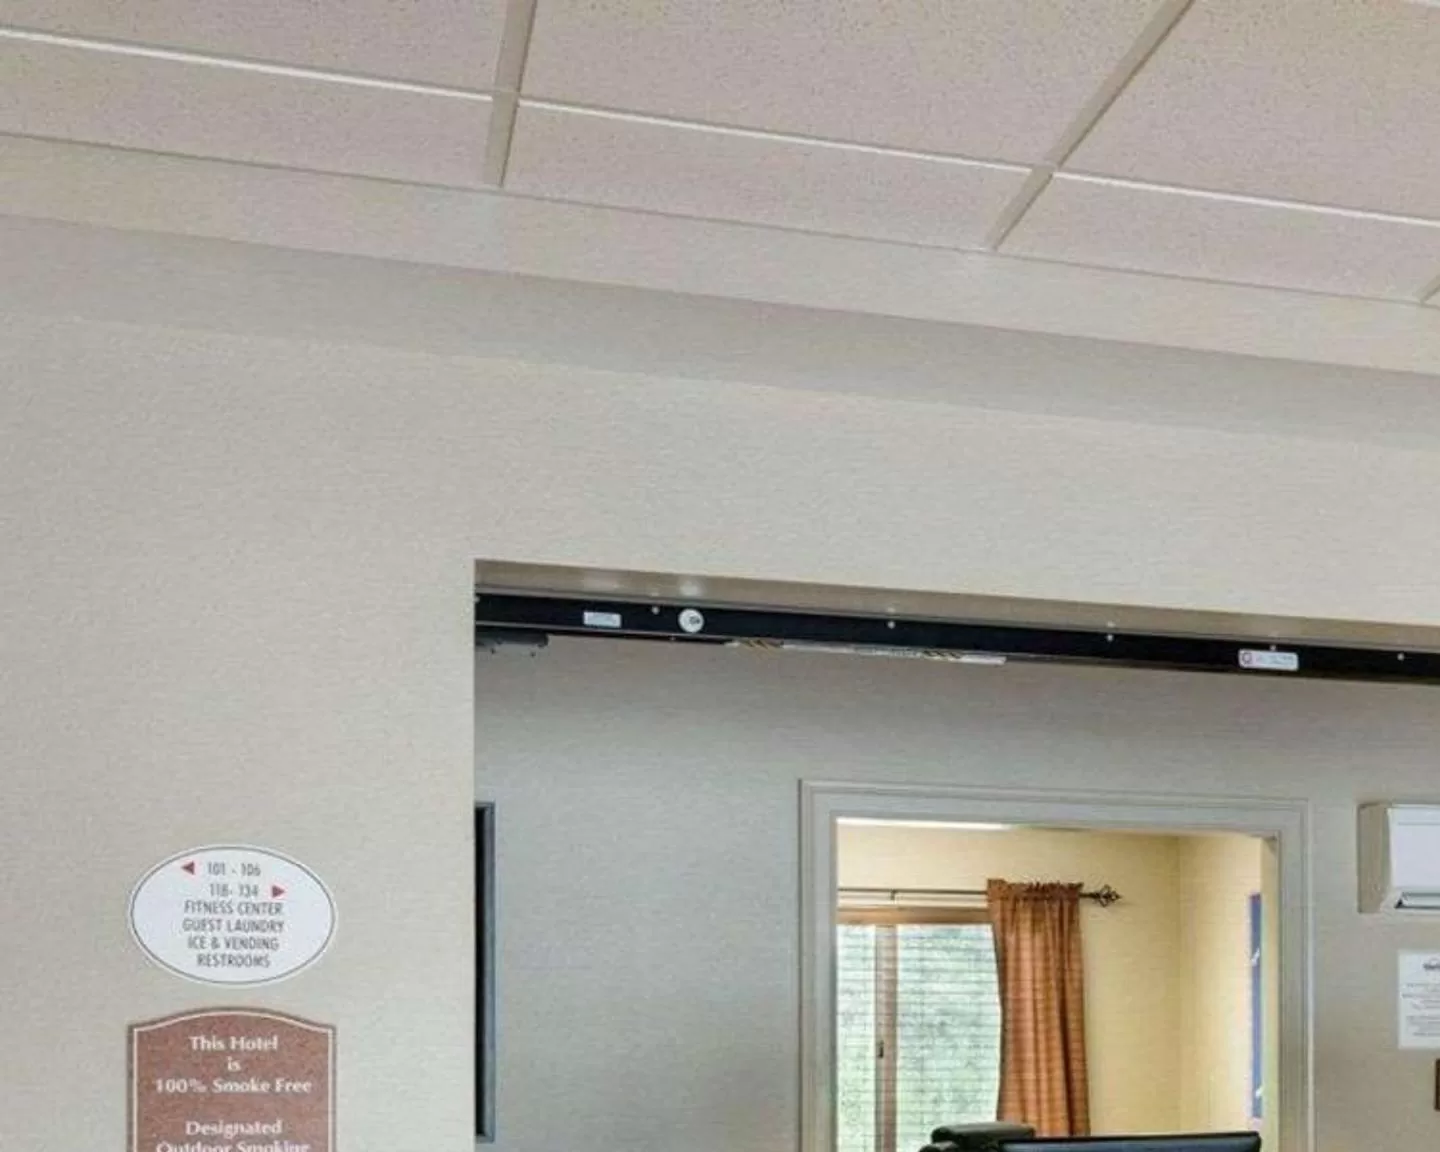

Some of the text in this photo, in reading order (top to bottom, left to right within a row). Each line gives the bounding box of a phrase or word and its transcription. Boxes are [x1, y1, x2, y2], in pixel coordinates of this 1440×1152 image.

[184, 900, 283, 916] FITNESS CENTER
[182, 919, 284, 933] GUEST LAUNDRY
[187, 936, 279, 951] ICE & VENDING
[197, 953, 270, 968] RESTROOMS
[189, 1036, 278, 1050] This Hotel
[227, 1056, 241, 1072] is
[156, 1078, 312, 1093] 100% Smoke Free
[185, 1120, 282, 1139] Designated
